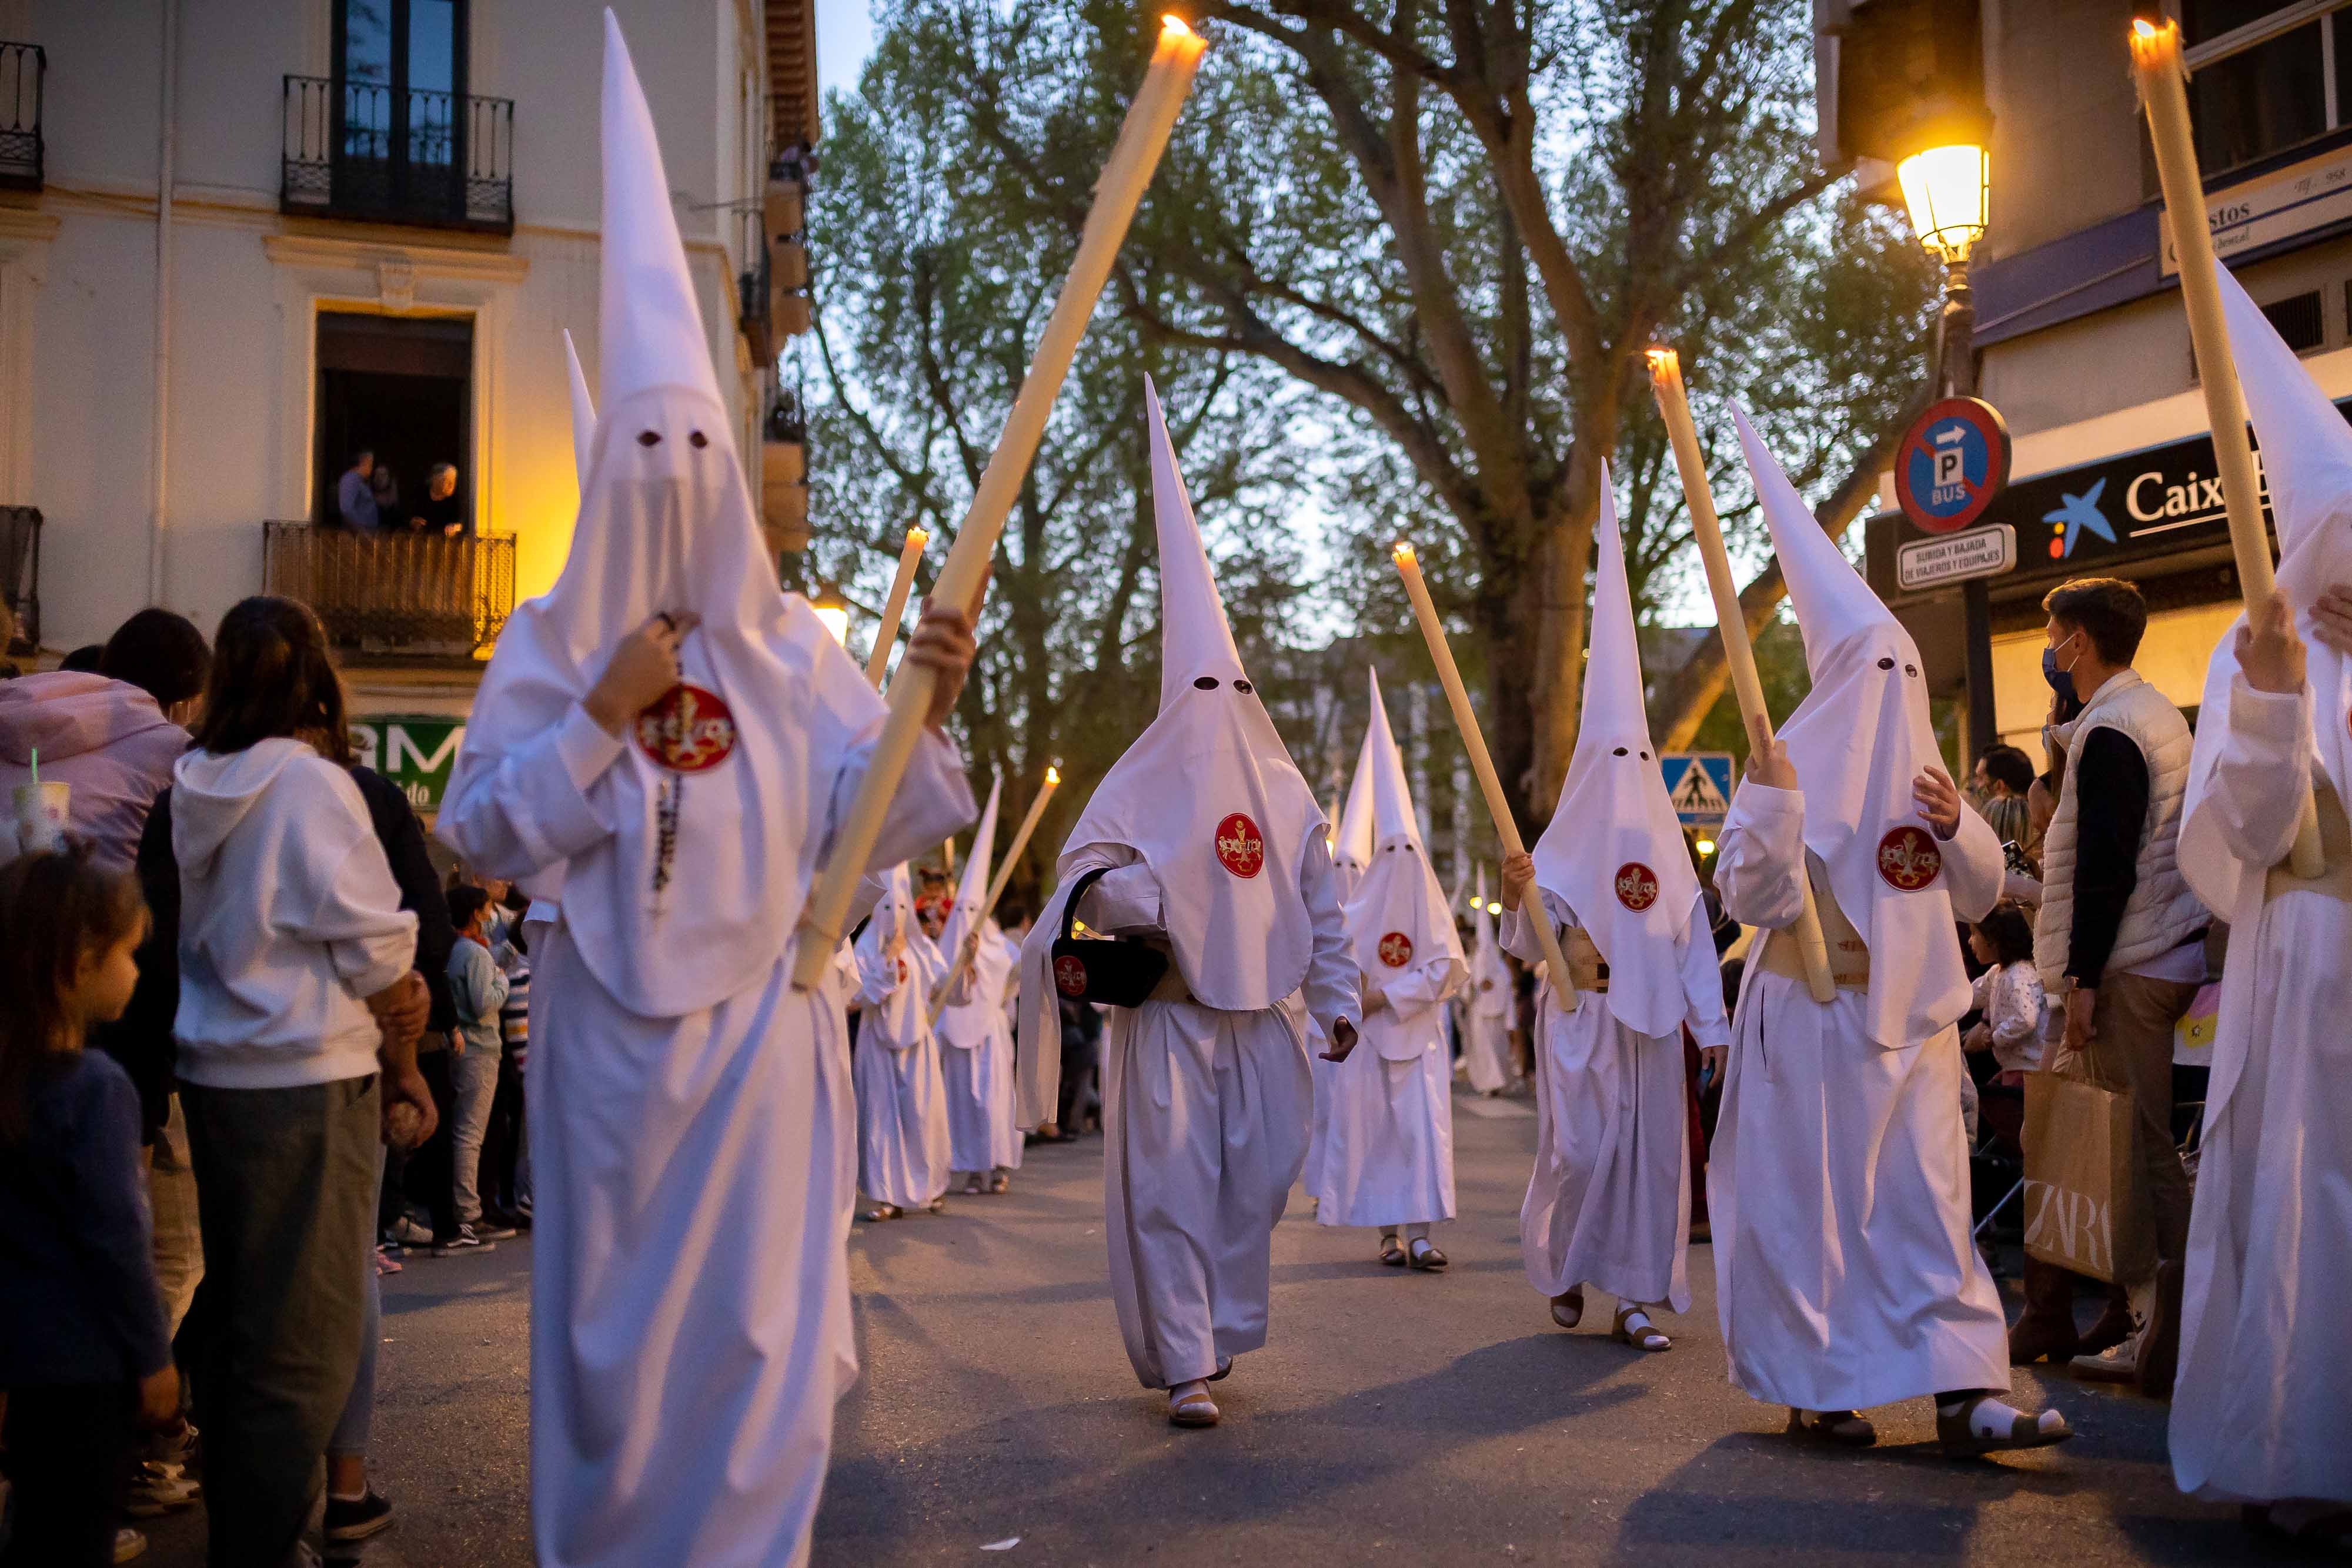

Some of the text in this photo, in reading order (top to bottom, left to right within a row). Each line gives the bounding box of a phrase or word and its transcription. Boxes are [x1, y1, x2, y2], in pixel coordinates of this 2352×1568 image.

[2209, 203, 2249, 226] stos
[1942, 454, 1957, 480] P
[1932, 484, 1966, 506] BUS
[1947, 544, 1953, 554] Y
[1955, 538, 1986, 554] BAJADA
[1916, 561, 1951, 577] VIAJEROS
[1952, 560, 1957, 569] Y
[1959, 550, 1999, 569] EQUIPAJES
[396, 780, 430, 807] do
